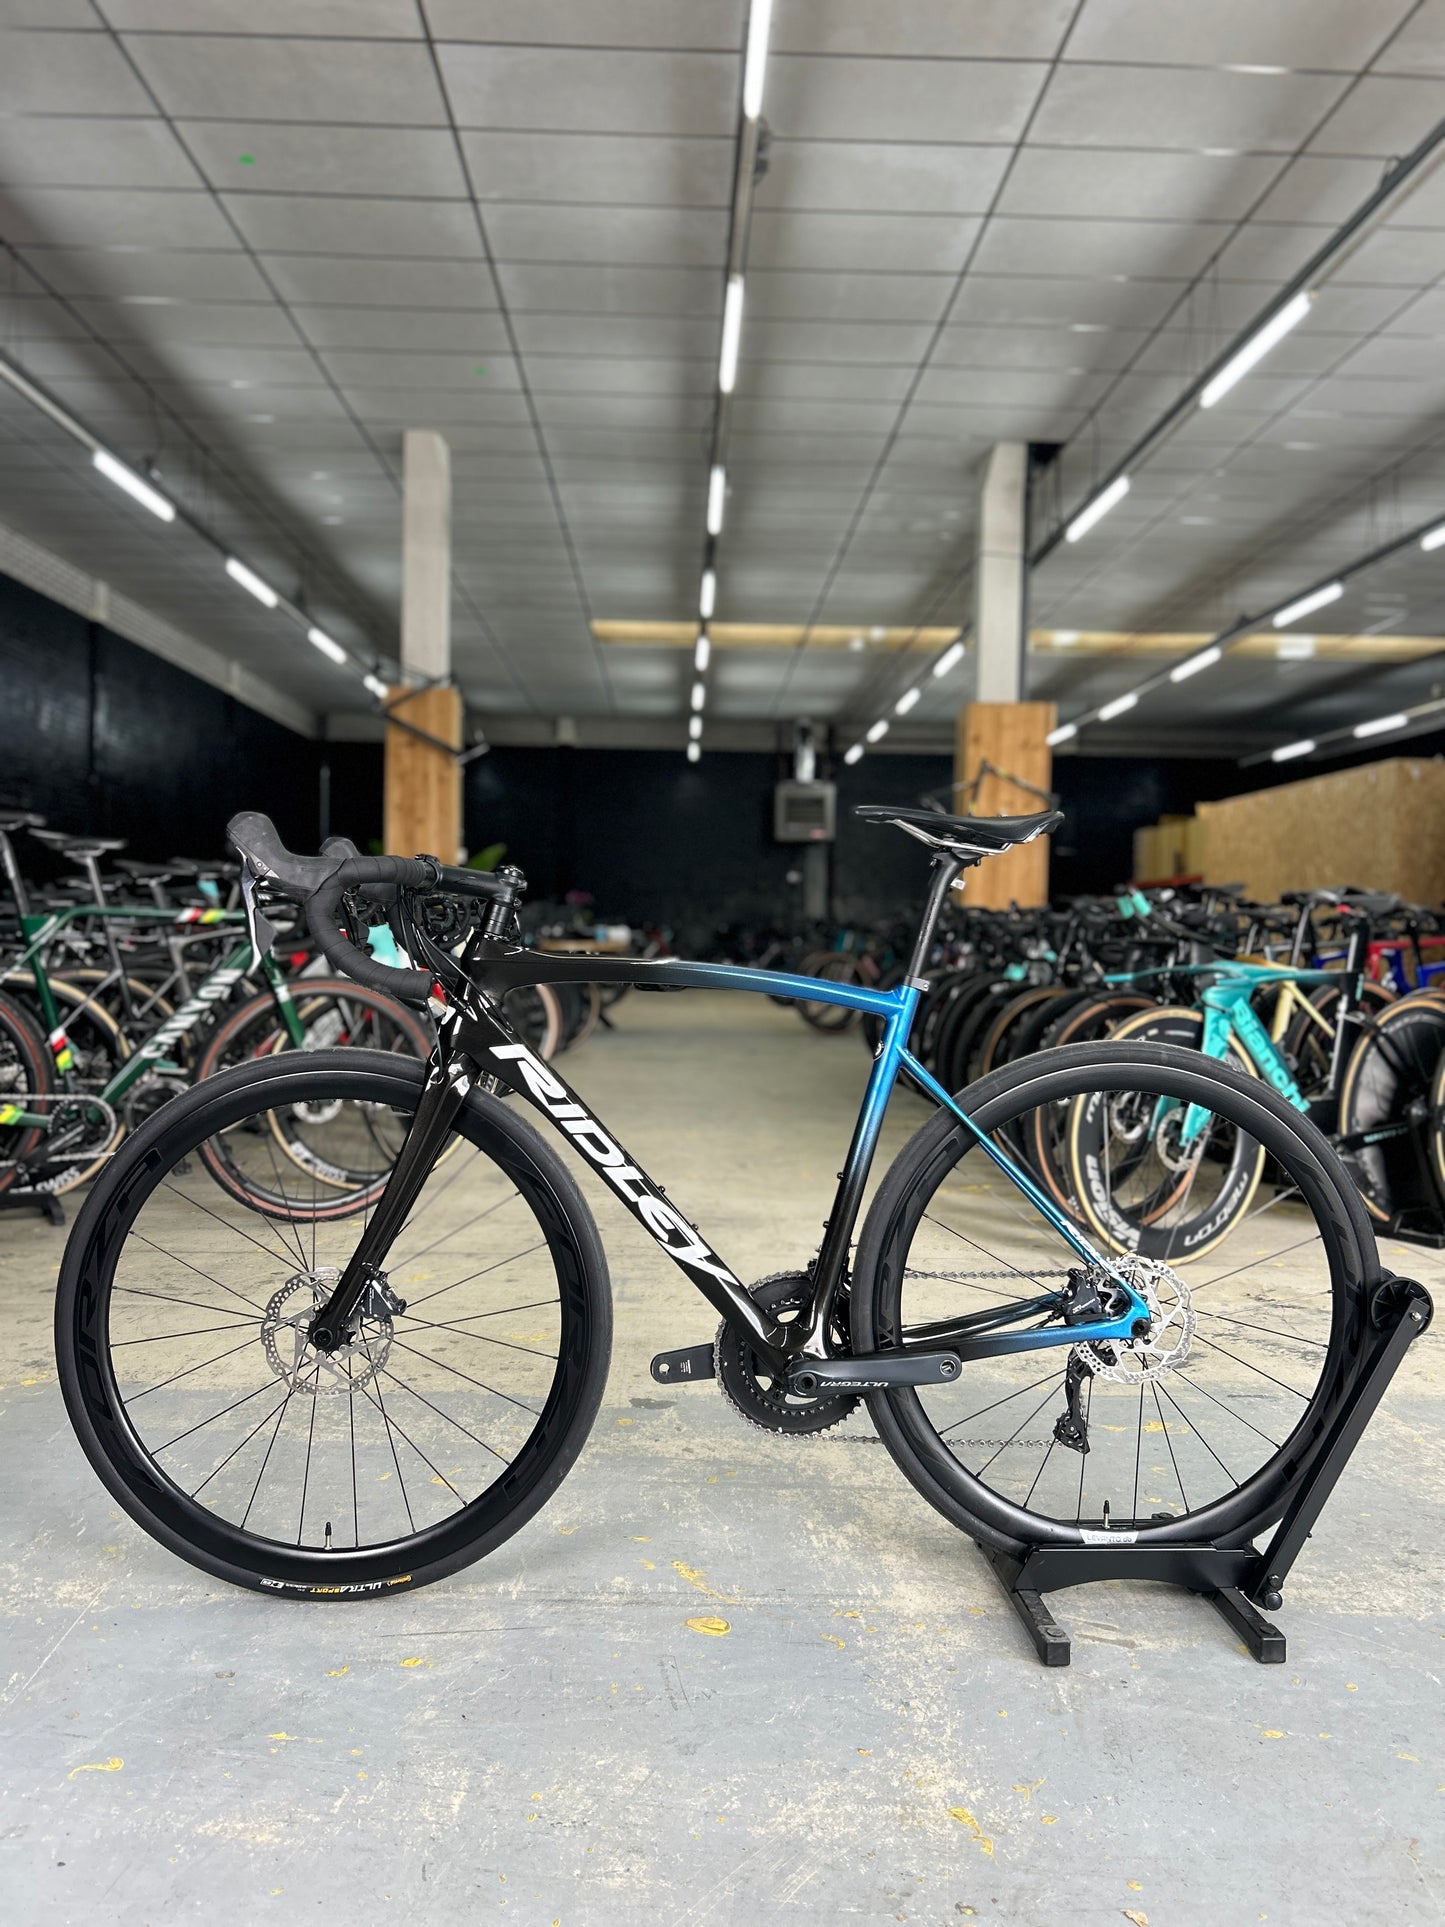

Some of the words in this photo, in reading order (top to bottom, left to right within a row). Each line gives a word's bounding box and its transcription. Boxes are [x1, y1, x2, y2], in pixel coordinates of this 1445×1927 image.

[139, 968, 244, 1058] CANYON
[1231, 996, 1311, 1113] Bianchi
[488, 1043, 740, 1286] RIDLEY
[1183, 1171, 1249, 1247] metron
[820, 1380, 889, 1388] ULTEGRA
[339, 1581, 382, 1593] ULTRA
